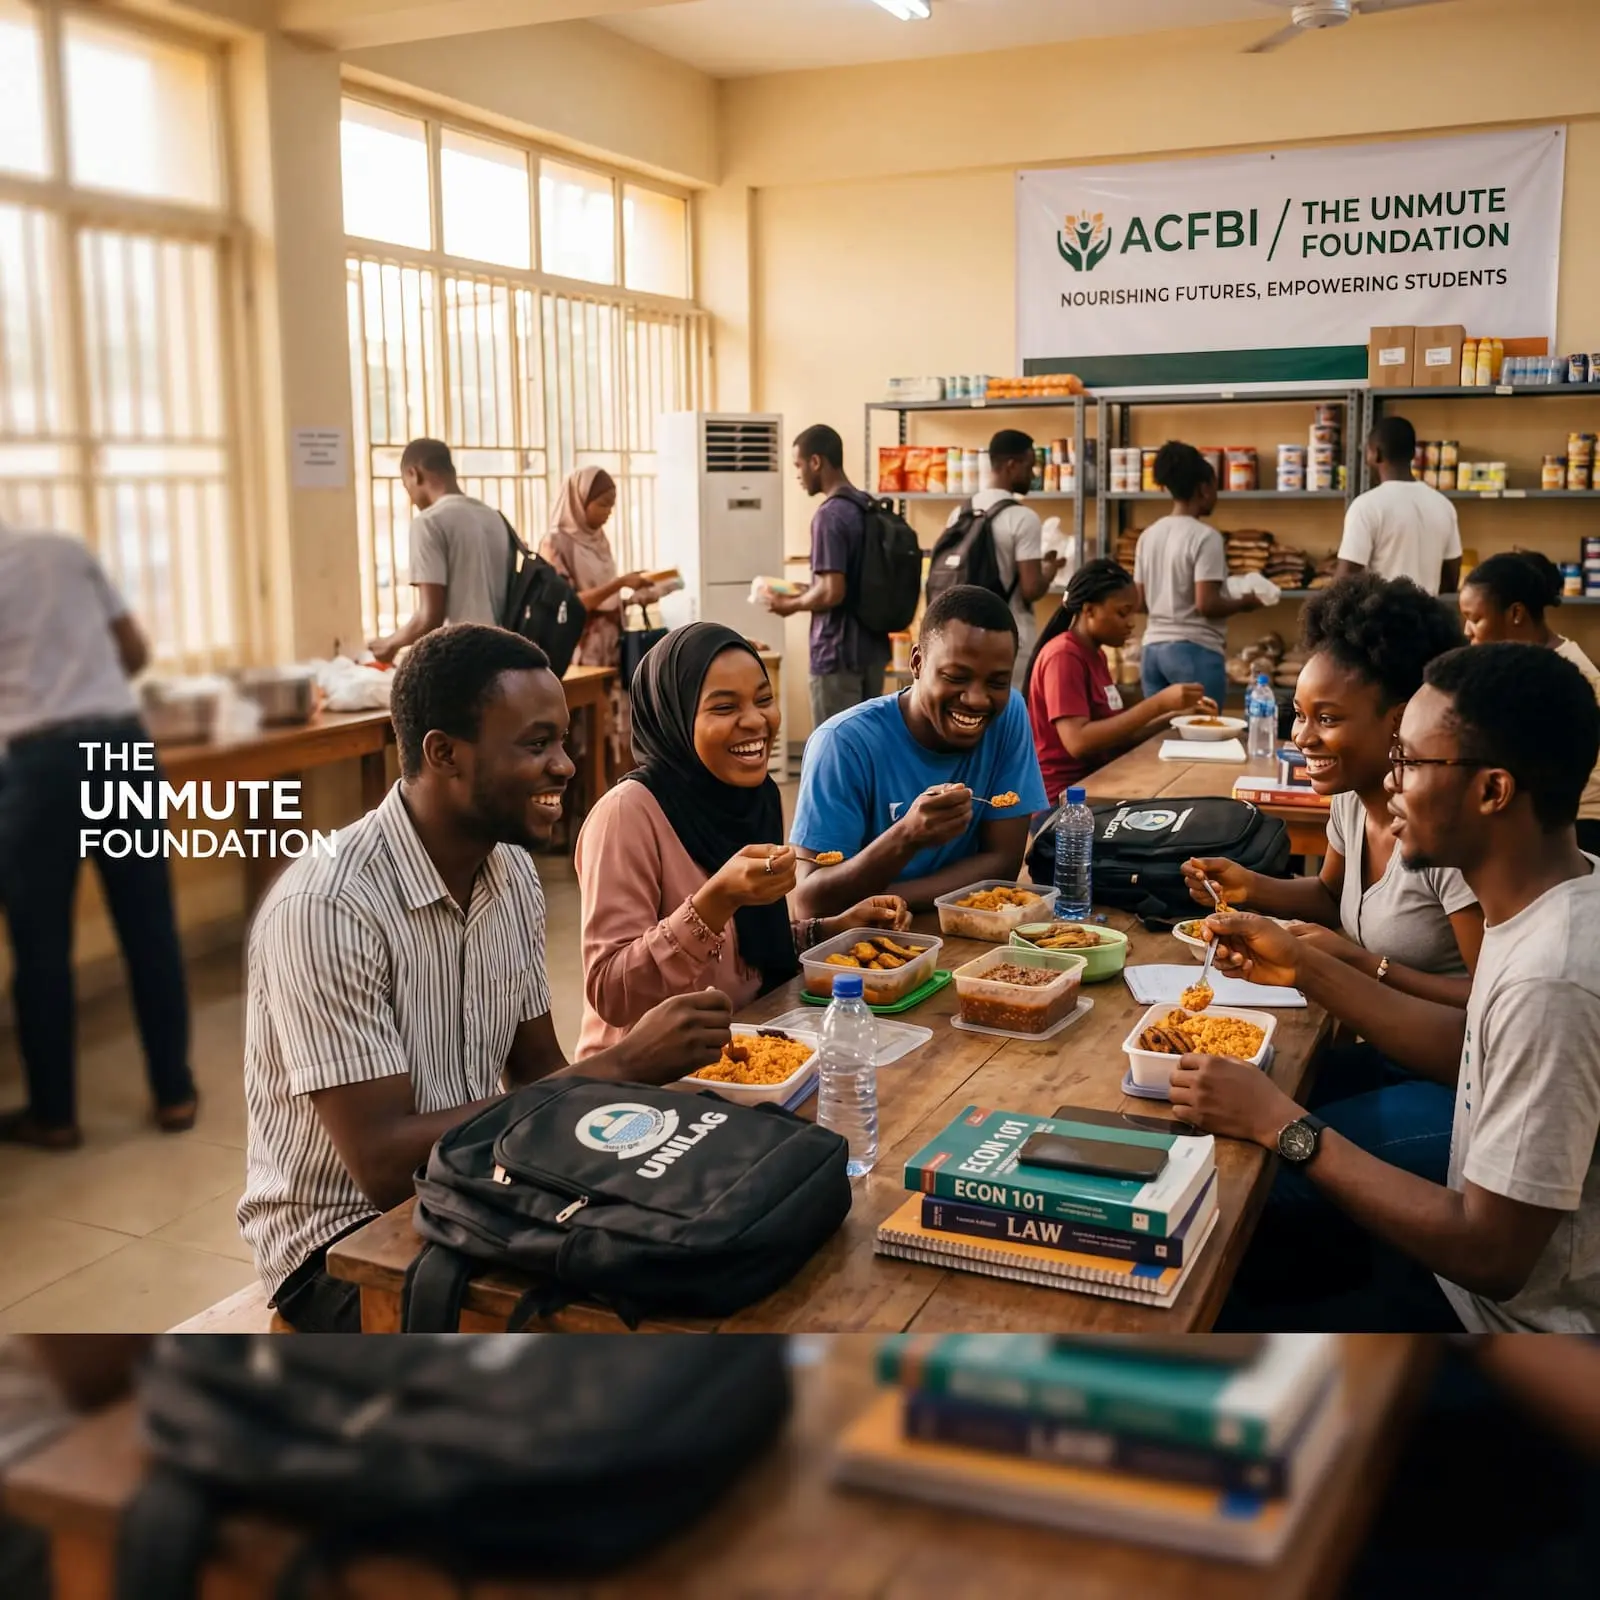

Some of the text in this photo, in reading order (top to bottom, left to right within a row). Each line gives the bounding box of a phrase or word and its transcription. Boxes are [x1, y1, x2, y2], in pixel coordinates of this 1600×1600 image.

[1302, 187, 1506, 225] THE UNMUTE
[1120, 208, 1258, 254] ACFBI
[1302, 222, 1510, 259] FOUNDATION
[1060, 268, 1508, 308] NOURISHING FUTURES, EMPOWERING STUDENTS
[635, 1111, 729, 1179] UNILAG
[958, 1140, 1010, 1174] ECON
[993, 1119, 1030, 1140] 101
[954, 1178, 1007, 1205] ECON
[1012, 1190, 1045, 1212] 101
[1007, 1216, 1063, 1245] LAW
